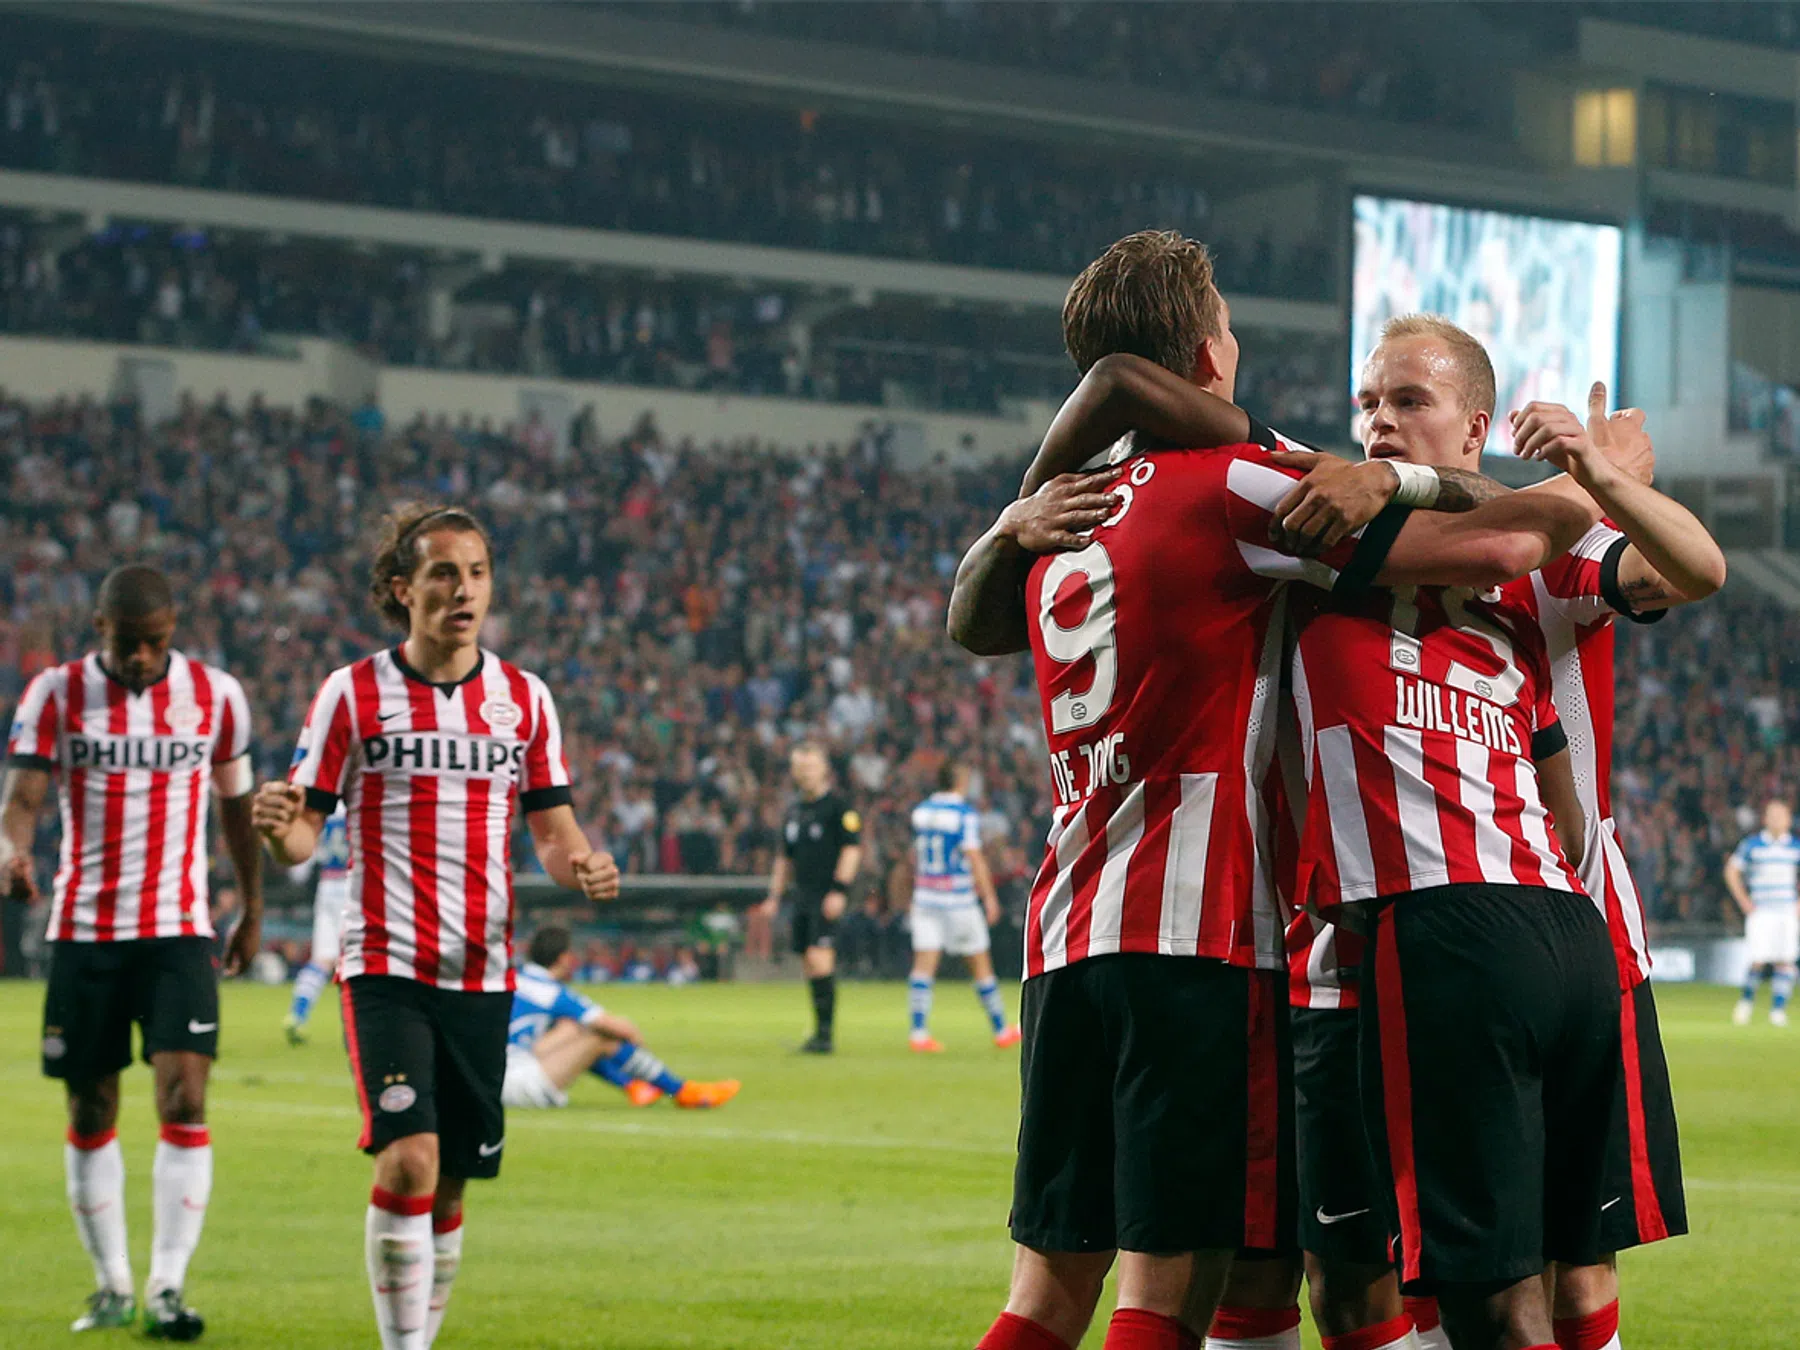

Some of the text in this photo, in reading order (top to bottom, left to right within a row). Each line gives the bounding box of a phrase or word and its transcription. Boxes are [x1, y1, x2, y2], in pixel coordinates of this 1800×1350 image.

[1038, 540, 1118, 735] 9
[1396, 674, 1523, 756] WILLEMS
[70, 738, 207, 767] PHILIPS
[364, 735, 525, 775] PHILIPS
[1050, 731, 1131, 805] DE JONG
